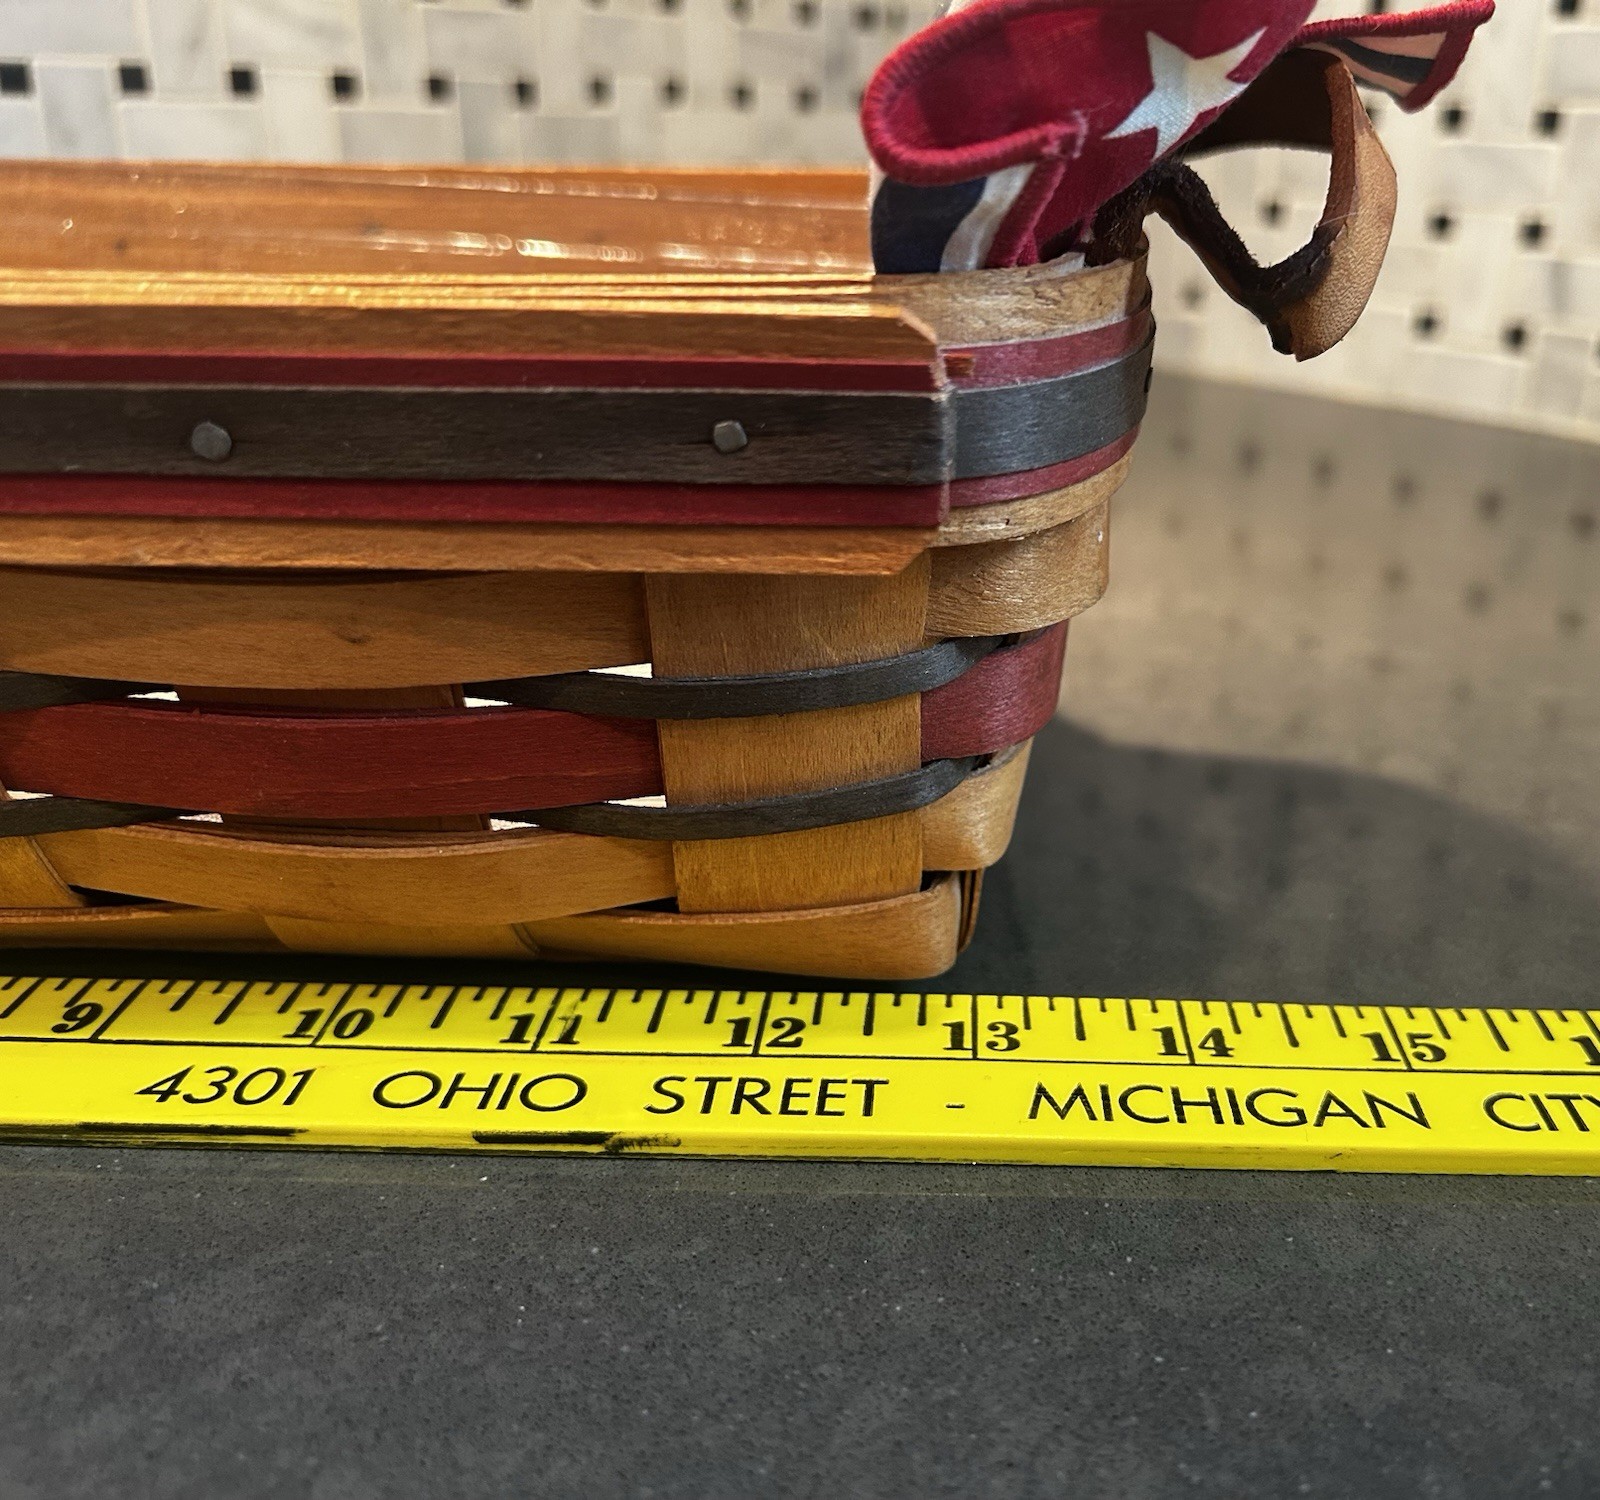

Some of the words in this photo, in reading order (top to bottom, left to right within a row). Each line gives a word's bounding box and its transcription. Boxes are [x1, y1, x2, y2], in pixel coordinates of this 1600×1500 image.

[51, 1002, 104, 1034] 9
[283, 1007, 376, 1040] 10
[499, 1012, 581, 1045] 11
[722, 1016, 806, 1049] 12
[941, 1020, 1020, 1053] 13
[1154, 1025, 1235, 1058] 14
[1361, 1032, 1447, 1064] 15
[135, 1065, 316, 1106] 4301
[372, 1070, 588, 1112] OHIO
[643, 1075, 889, 1117] STREET
[1028, 1081, 1431, 1130] MICHIGAN
